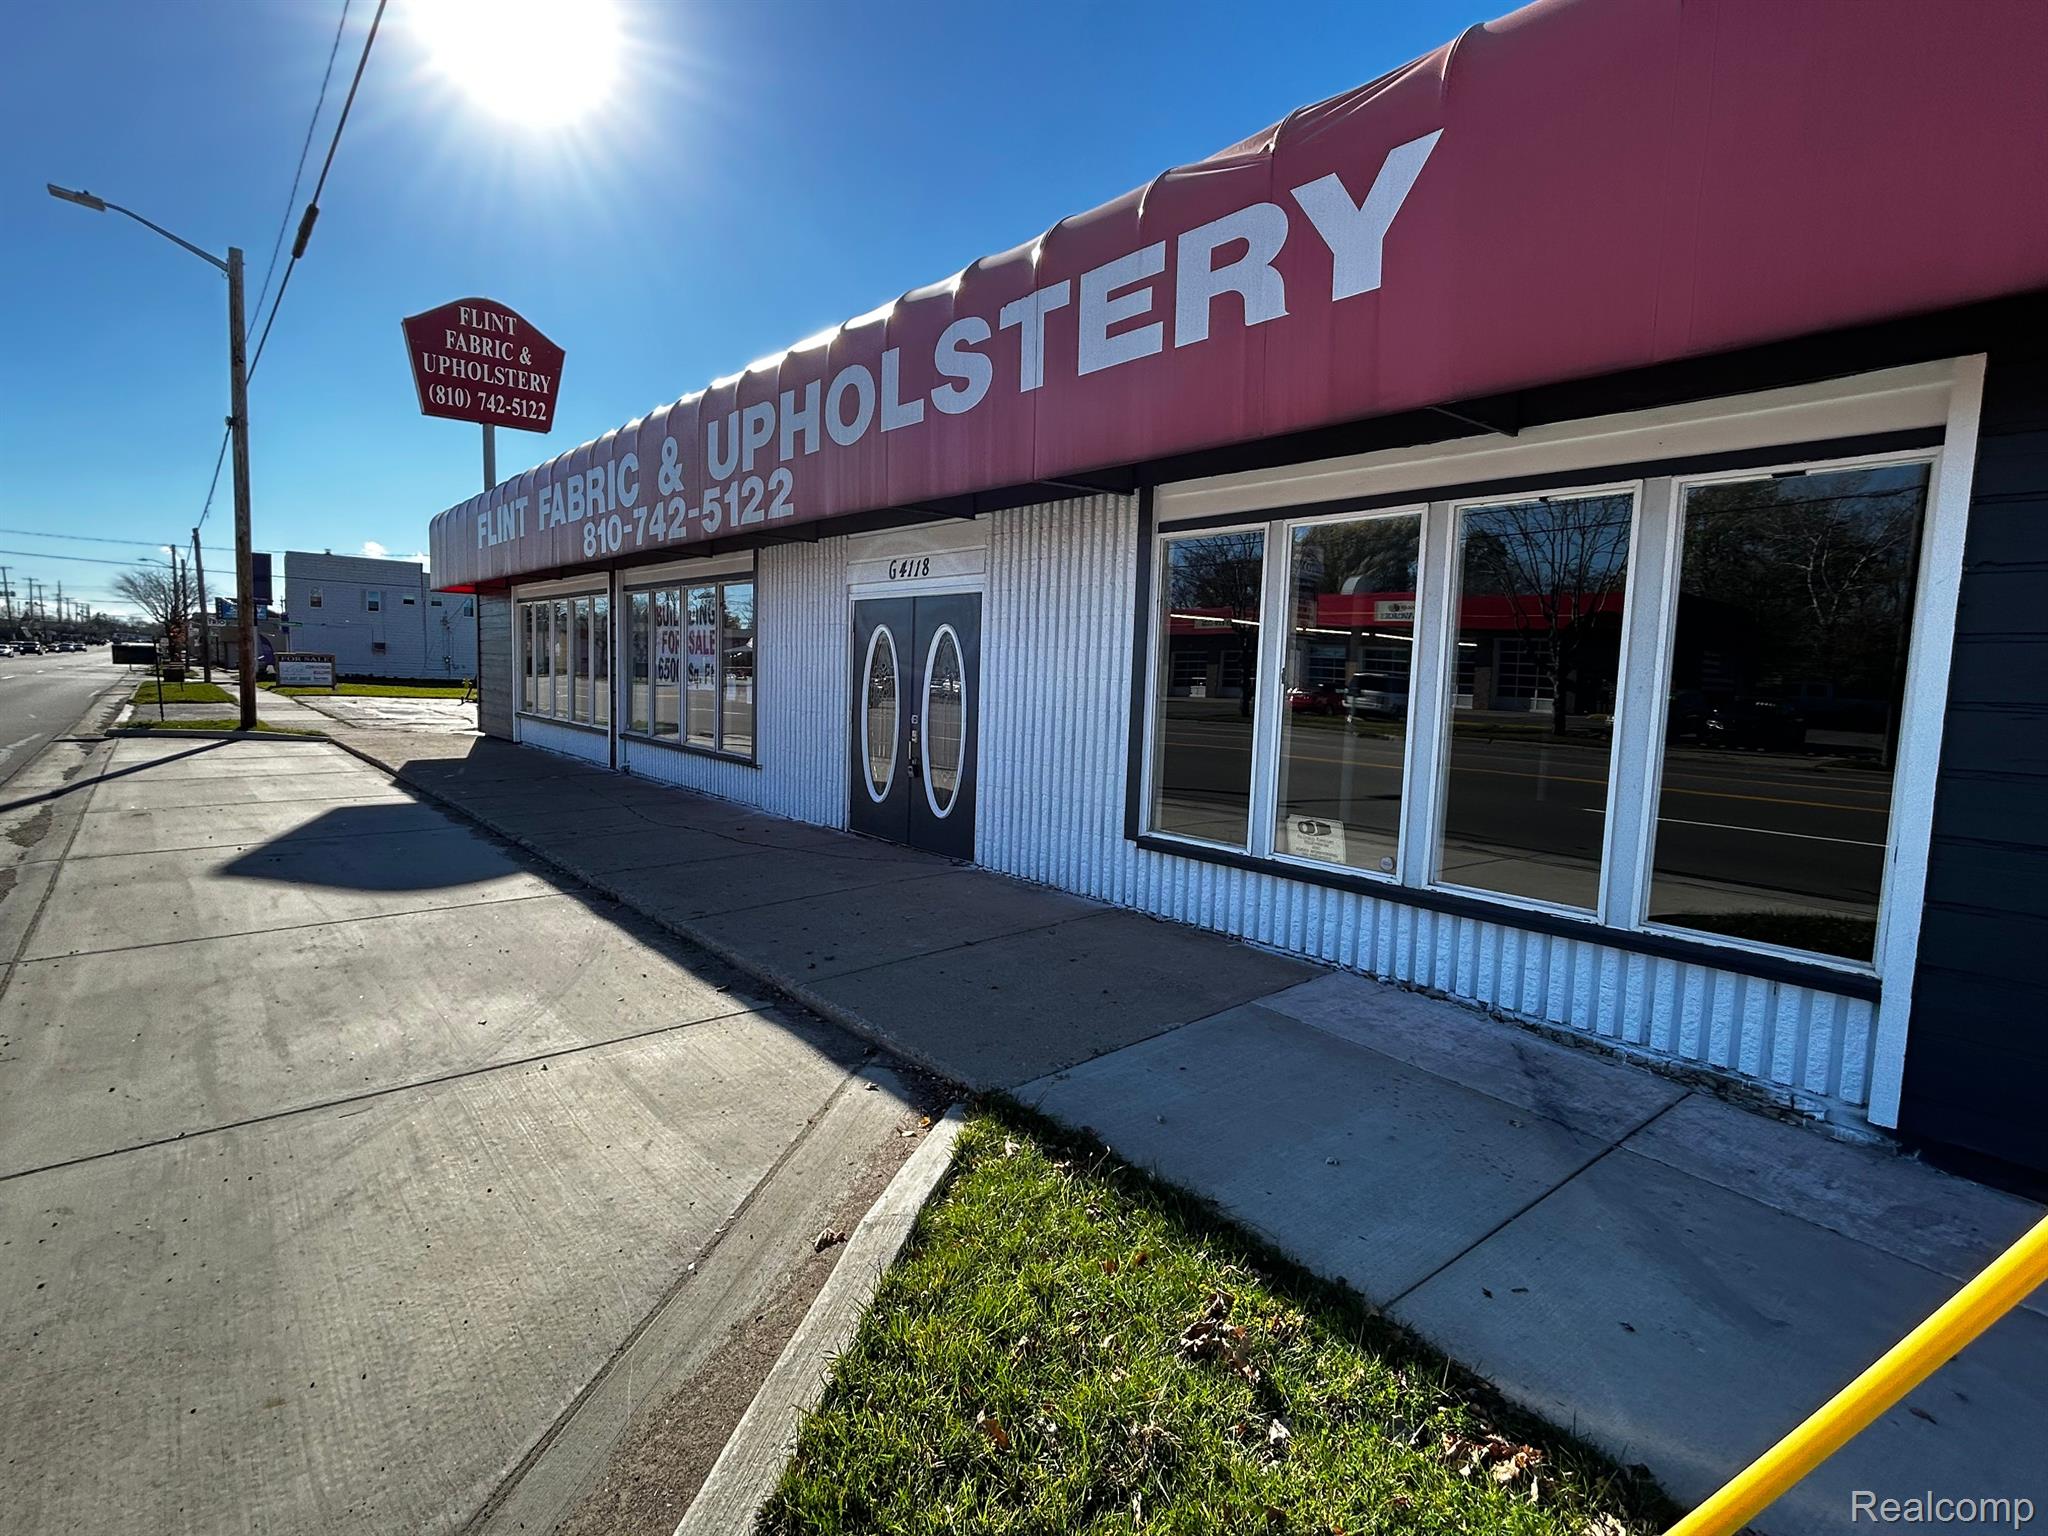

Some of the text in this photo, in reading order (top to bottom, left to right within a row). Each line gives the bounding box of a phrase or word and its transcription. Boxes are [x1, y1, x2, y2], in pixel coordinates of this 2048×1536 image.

[458, 306, 517, 336] FLINT
[477, 127, 1445, 549] FLINT FABRIC & UPHOLSTERY
[445, 329, 532, 366] FABRIC &
[422, 352, 551, 395] UPHOLSTERY
[428, 383, 547, 421] (810) 742-5122
[583, 467, 795, 558] 810-742-5122
[688, 629, 715, 655] SALE
